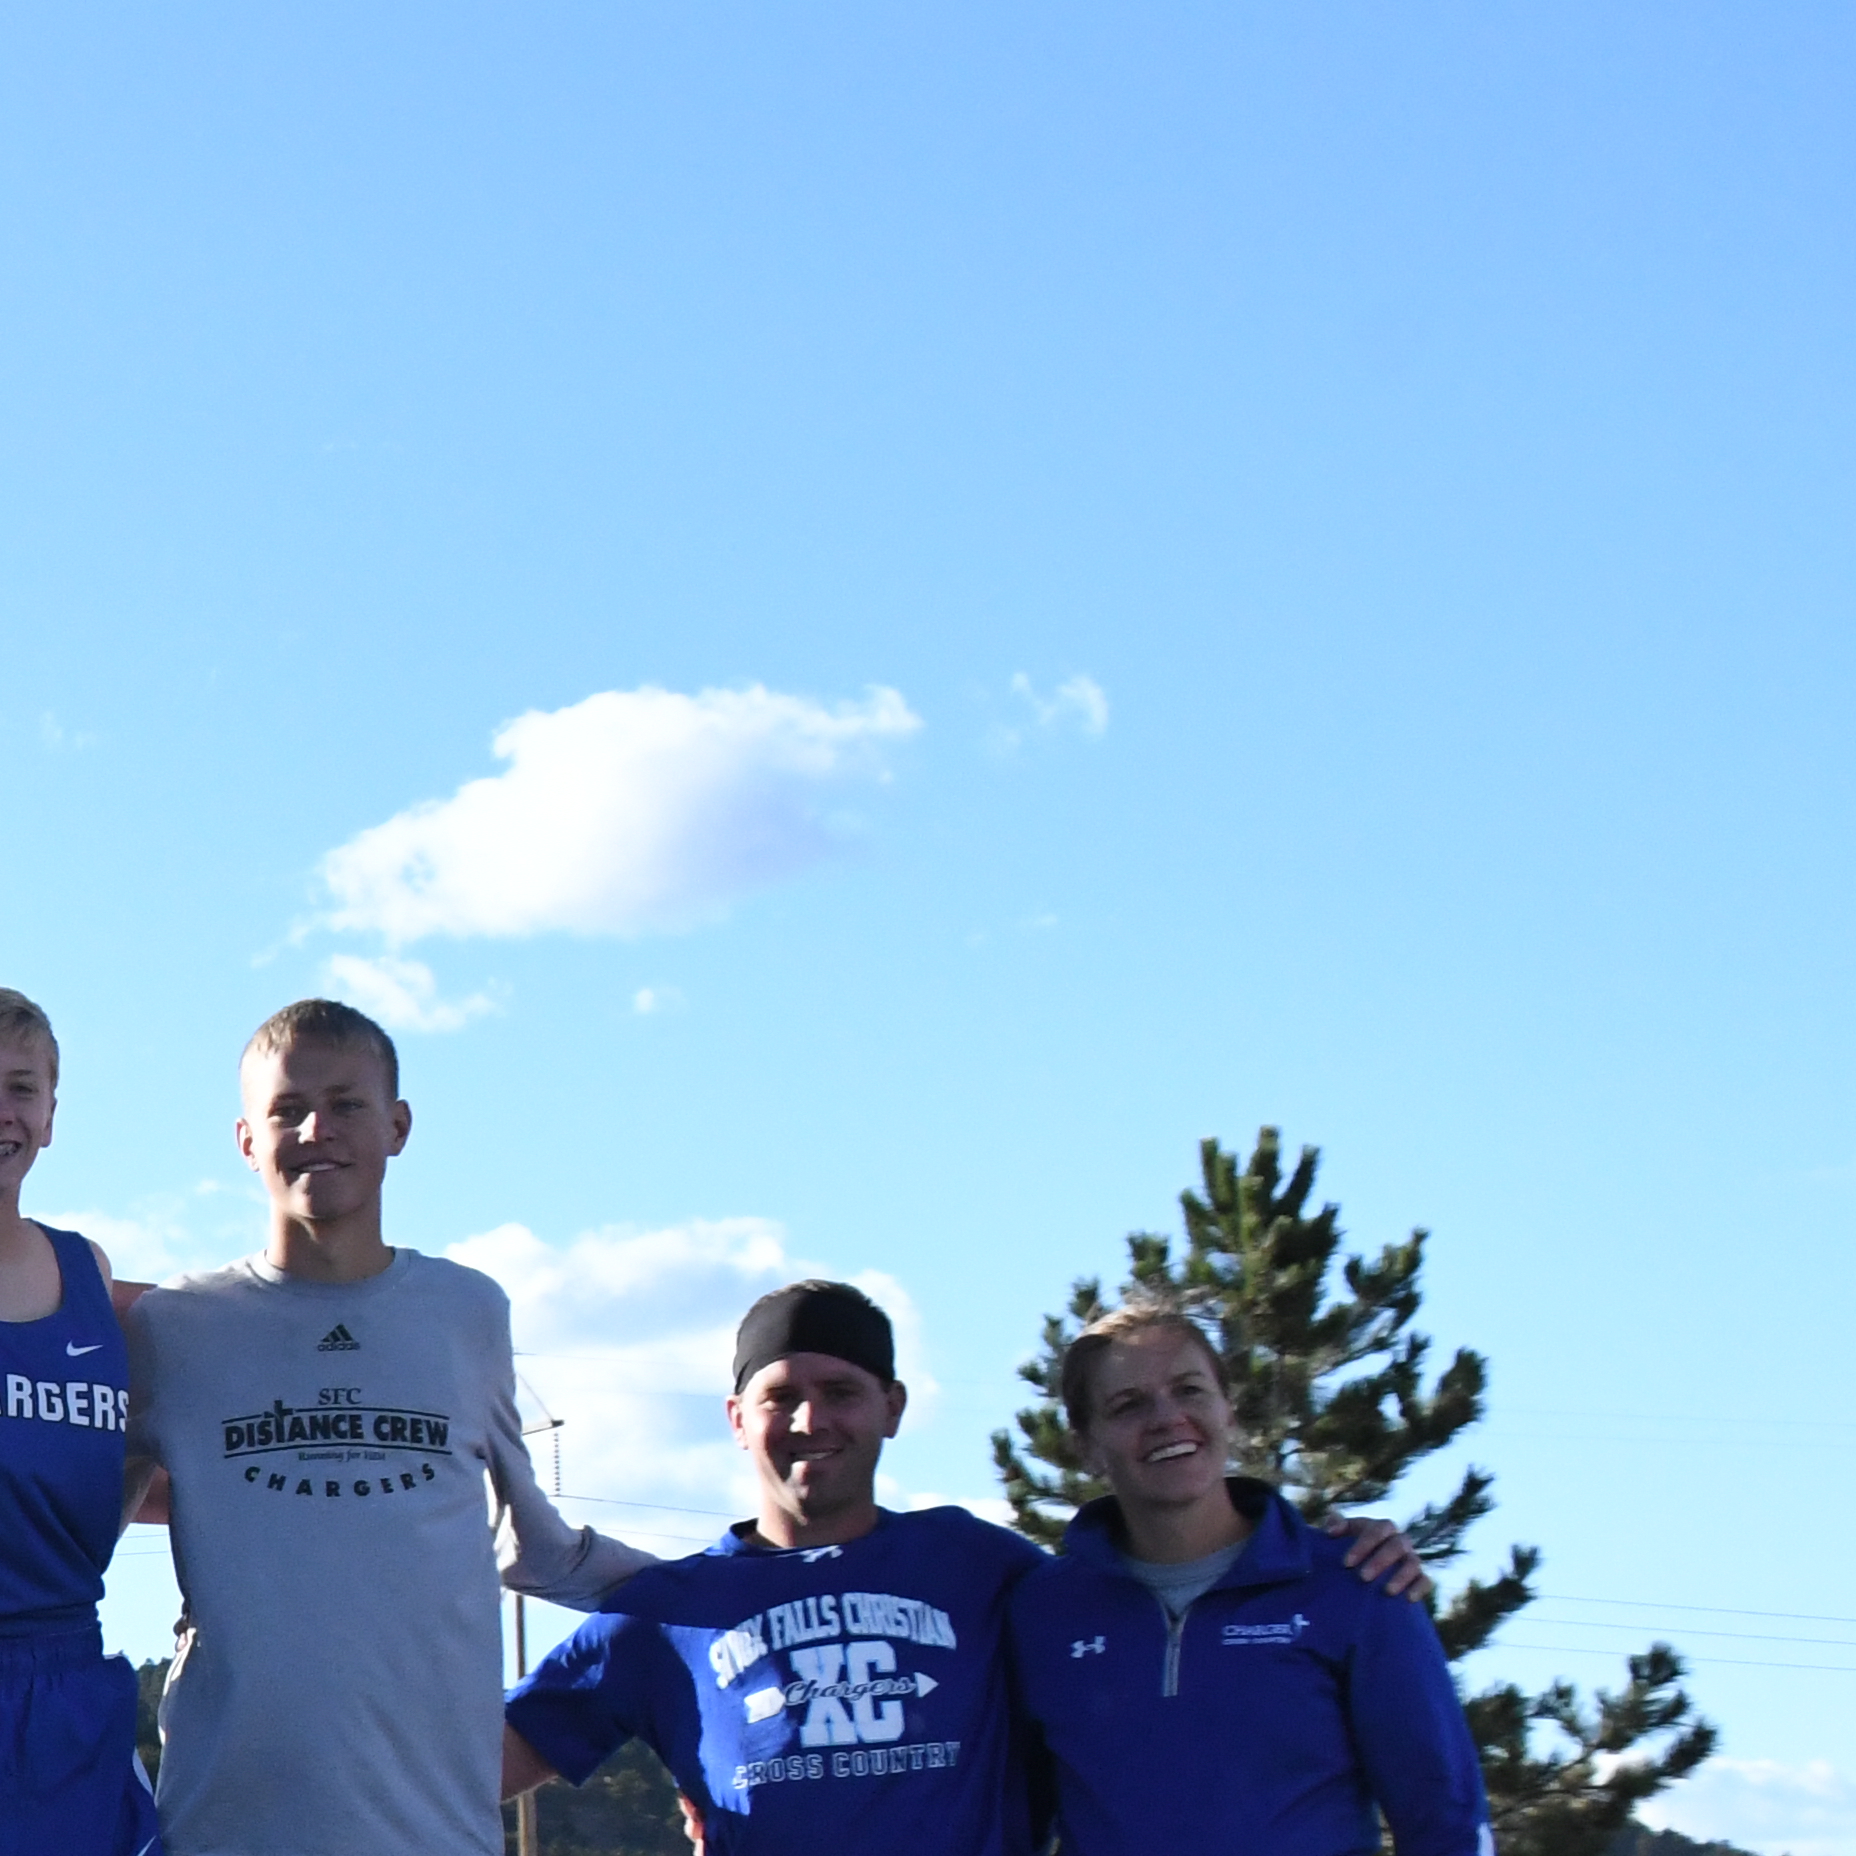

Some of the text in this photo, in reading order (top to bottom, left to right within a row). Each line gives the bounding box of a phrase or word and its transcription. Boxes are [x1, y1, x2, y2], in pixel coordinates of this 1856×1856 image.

[318, 1388, 362, 1405] SFC
[225, 1400, 449, 1451] DISTANCE CREW
[244, 1463, 435, 1497] CHARGERS
[767, 1594, 841, 1651] FALLS
[841, 1592, 957, 1651] CHRISTIAN
[785, 1676, 916, 1707] Chargers
[790, 1640, 906, 1748] XC
[732, 1741, 961, 1790] CROSS COUNTRY
